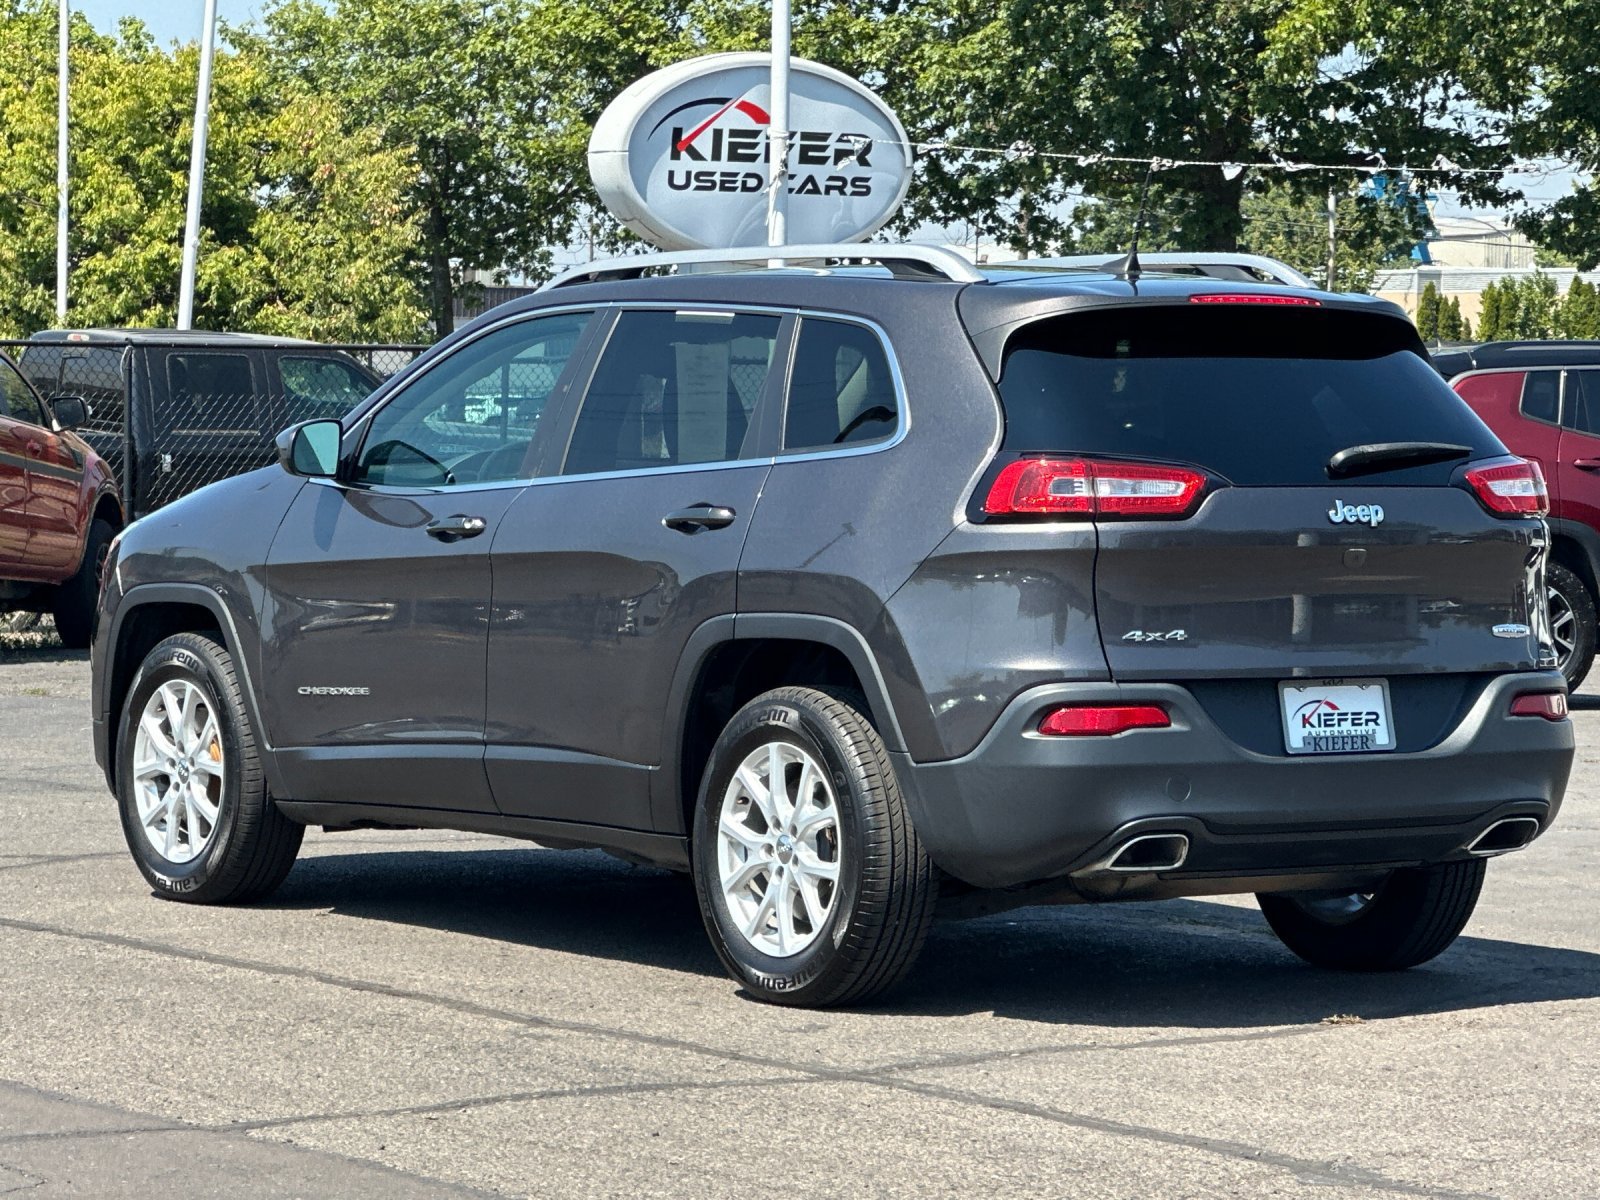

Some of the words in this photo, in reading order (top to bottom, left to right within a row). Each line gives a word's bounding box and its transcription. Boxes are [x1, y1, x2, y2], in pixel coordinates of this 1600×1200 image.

[667, 170, 764, 193] USED
[1328, 499, 1385, 527] Jeep
[1121, 629, 1188, 642] 4x4
[297, 686, 371, 695] CHEROKEE
[1302, 711, 1381, 729] KIEFER
[1308, 728, 1377, 737] AUTOMOTIVE
[1313, 735, 1371, 752] KIEFER
